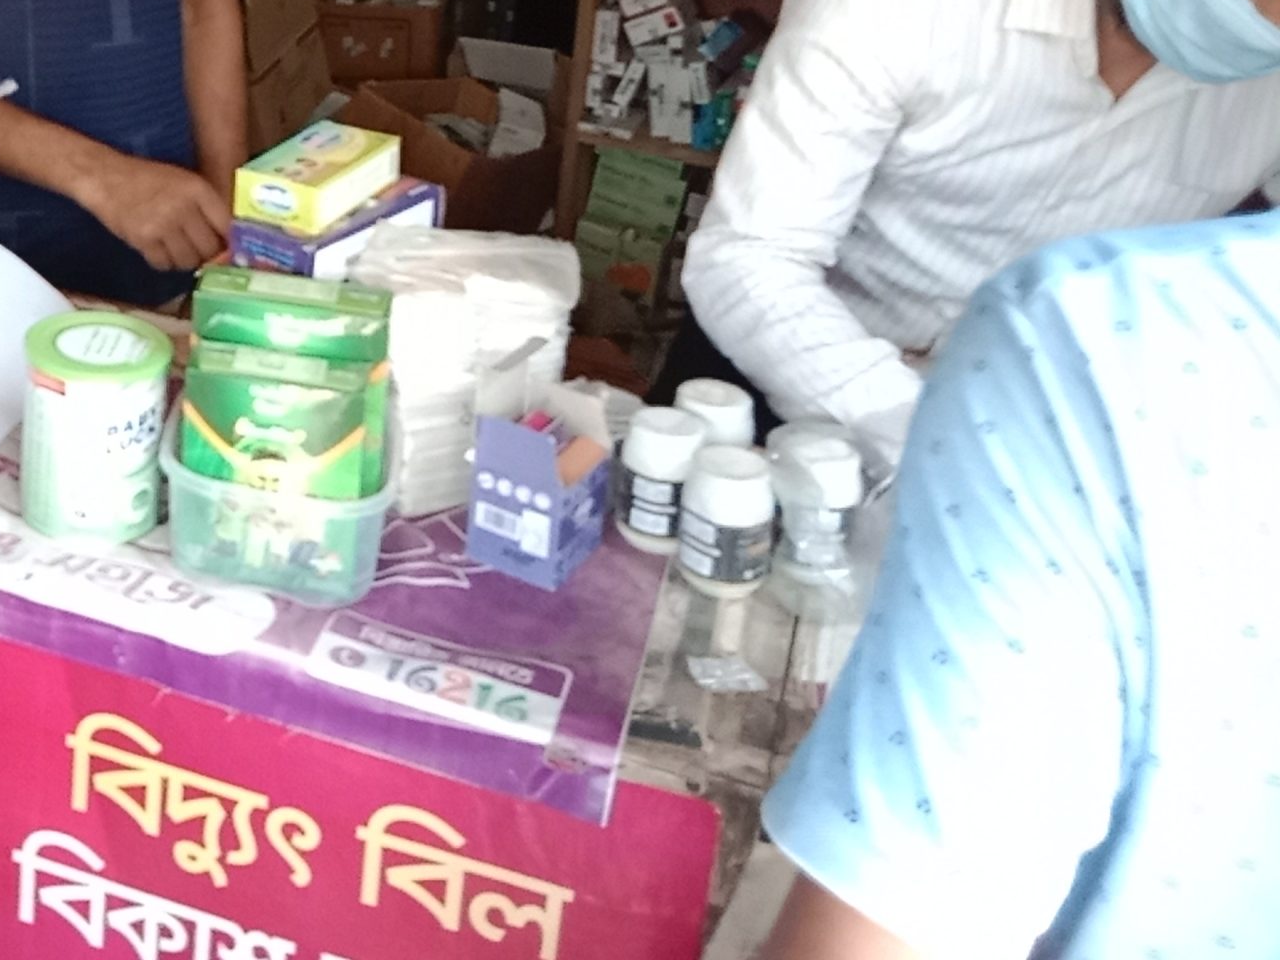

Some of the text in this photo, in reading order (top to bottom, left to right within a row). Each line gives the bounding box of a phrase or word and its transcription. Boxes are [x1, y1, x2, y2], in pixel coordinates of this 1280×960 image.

[384, 658, 529, 723] 16216
[65, 712, 575, 960] বিদ্যুৎ বিল
